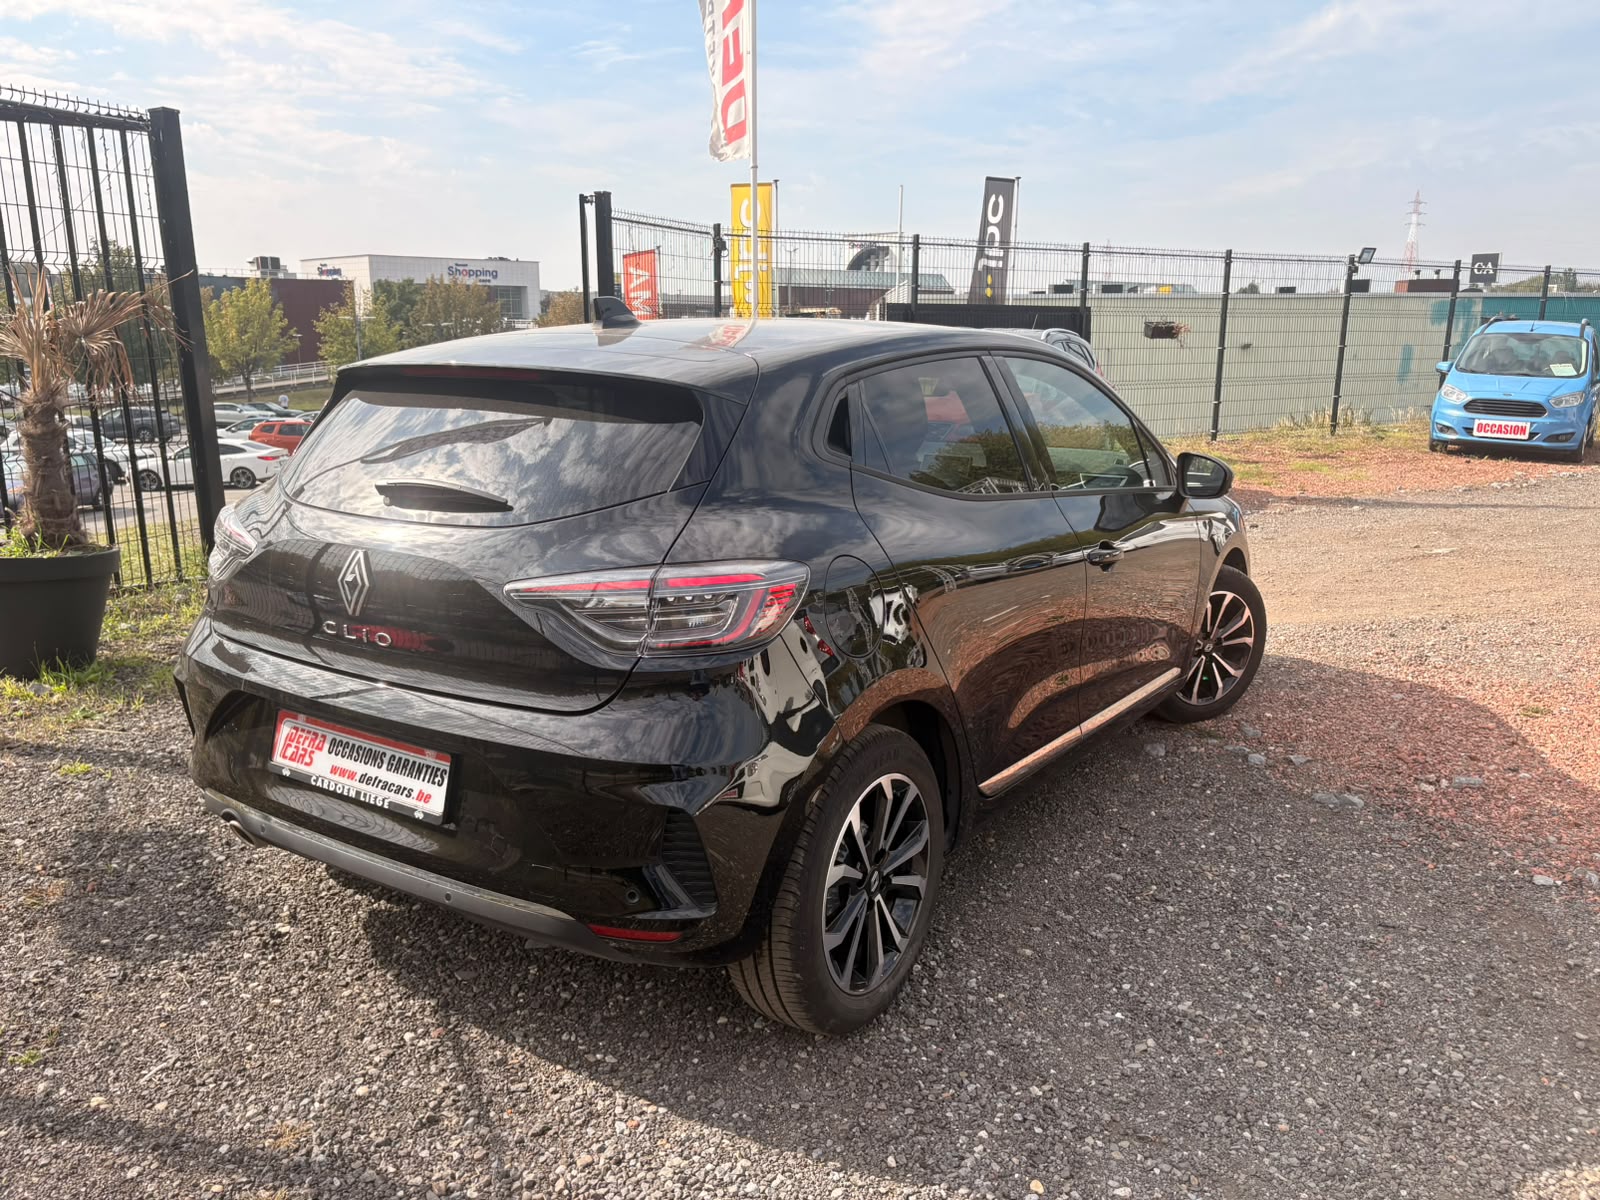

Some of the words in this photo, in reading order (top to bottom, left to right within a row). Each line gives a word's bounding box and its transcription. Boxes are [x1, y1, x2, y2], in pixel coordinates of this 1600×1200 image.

[448, 265, 498, 279] Shopping
[1476, 422, 1527, 436] OCCASION
[322, 620, 392, 647] CLIO
[327, 737, 386, 769] OCCASIONS
[386, 753, 448, 788] GARANTIES
[310, 775, 357, 798] CARDOEN
[360, 791, 390, 809] LIEGE
[329, 764, 432, 805] www.defracars.be
